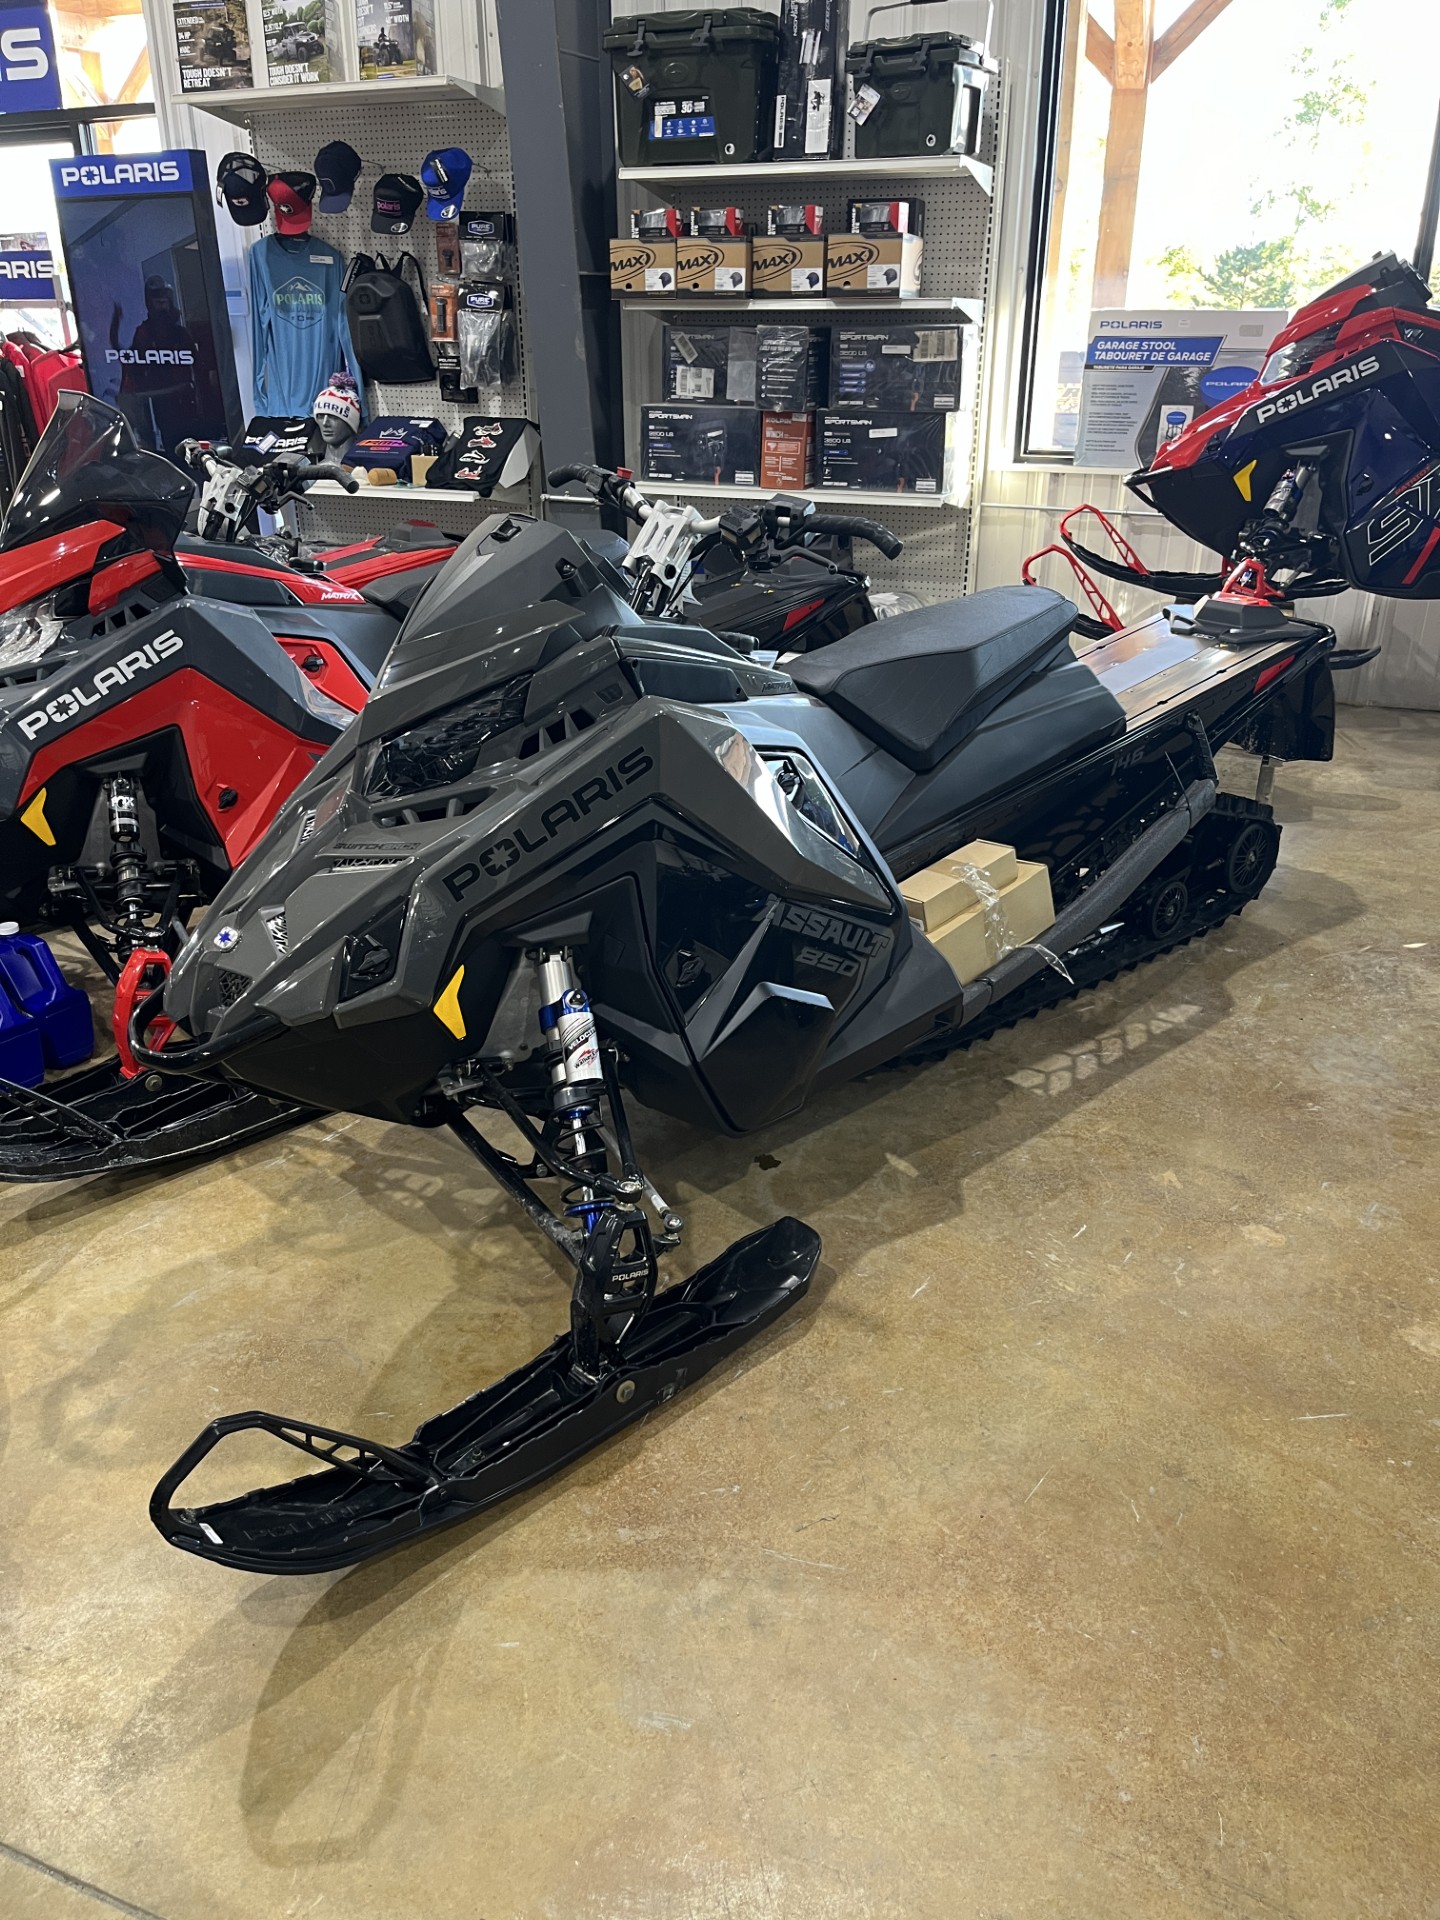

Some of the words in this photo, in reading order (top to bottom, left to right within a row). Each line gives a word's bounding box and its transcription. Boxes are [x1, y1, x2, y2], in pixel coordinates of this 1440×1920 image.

[182, 68, 202, 79] TOUGH
[203, 67, 232, 77] DOESN'T
[300, 72, 319, 82] WORK
[183, 78, 211, 88] RETREAT
[61, 161, 180, 187] POLARIS
[276, 293, 323, 305] POLARIS
[1100, 321, 1162, 329] POLARIS
[1097, 341, 1140, 350] GARAGE
[1141, 341, 1176, 350] STOOL
[105, 349, 195, 365] POLARIS
[1094, 351, 1149, 361] TABOURET
[1150, 352, 1166, 361] DE
[1167, 352, 1211, 361] GARAGE
[1256, 355, 1380, 424] POLARIS
[315, 402, 350, 418] LARIS
[321, 592, 359, 601] MATRYX
[17, 629, 184, 741] POLARIS
[1110, 745, 1145, 777] 146
[111, 796, 134, 809] FOX
[442, 745, 655, 902] POLARIS
[755, 896, 891, 958] ASSAULT
[795, 946, 860, 978] 850
[612, 1268, 649, 1282] POLARIS
